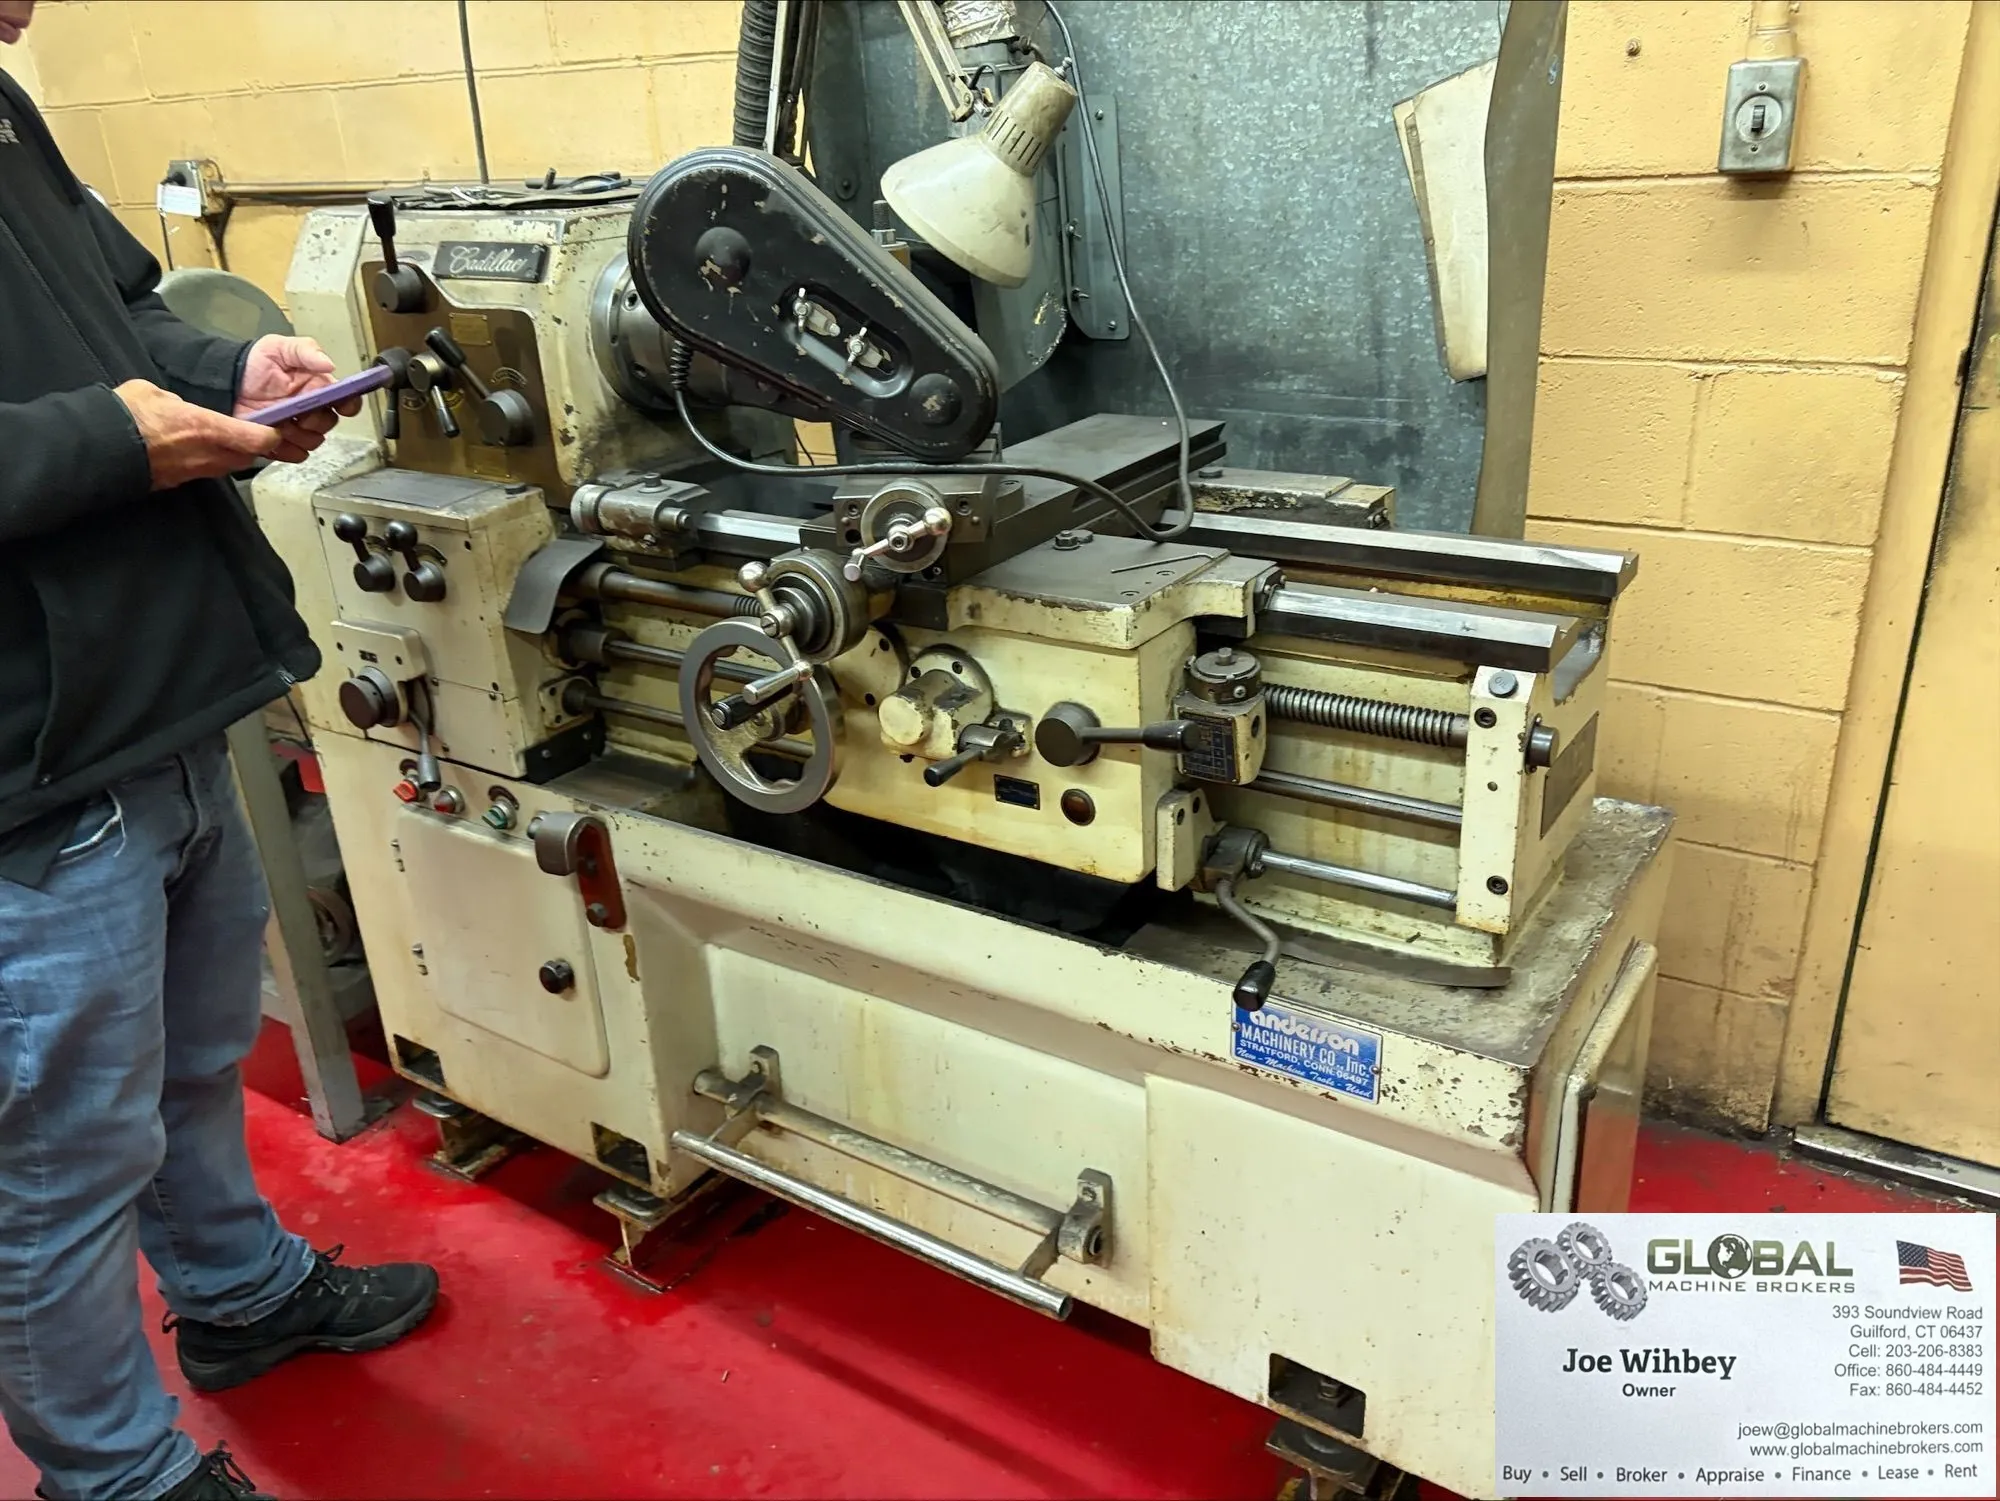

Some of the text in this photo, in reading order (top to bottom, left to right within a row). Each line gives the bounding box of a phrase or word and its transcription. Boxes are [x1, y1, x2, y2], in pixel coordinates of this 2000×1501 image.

[449, 246, 527, 273] Cadillac
[1241, 1022, 1315, 1060] MACHINERY
[1250, 1010, 1359, 1056] anderson
[1236, 1047, 1373, 1097] New Machine Tools Used
[1336, 1070, 1369, 1086] 06497
